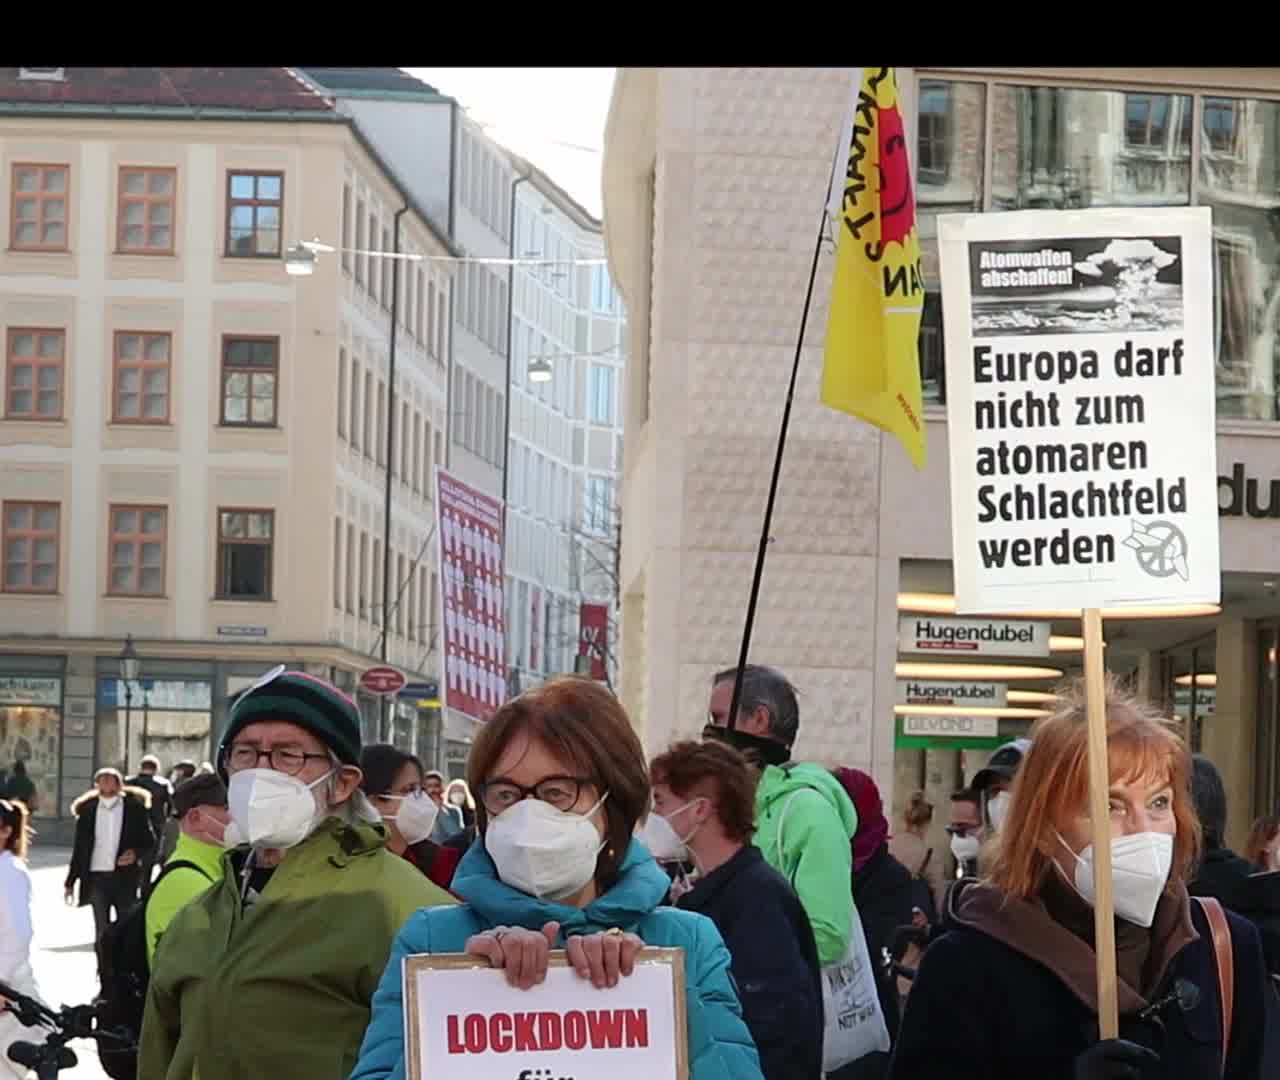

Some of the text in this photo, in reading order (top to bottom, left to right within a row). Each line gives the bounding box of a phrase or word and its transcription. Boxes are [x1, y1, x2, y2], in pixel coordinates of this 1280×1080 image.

[980, 249, 1072, 268] Atomwaffen
[981, 267, 1073, 288] abschaffen!
[973, 339, 1184, 384] Europa darf
[975, 391, 1144, 430] nicht zum
[976, 440, 1148, 476] atomaren
[978, 477, 1187, 523] Schlachtfeld
[978, 528, 1114, 568] werden
[916, 621, 1034, 642] Hugendubel
[906, 683, 996, 701] Hugendubel
[447, 1008, 649, 1054] LOCKDOWN
